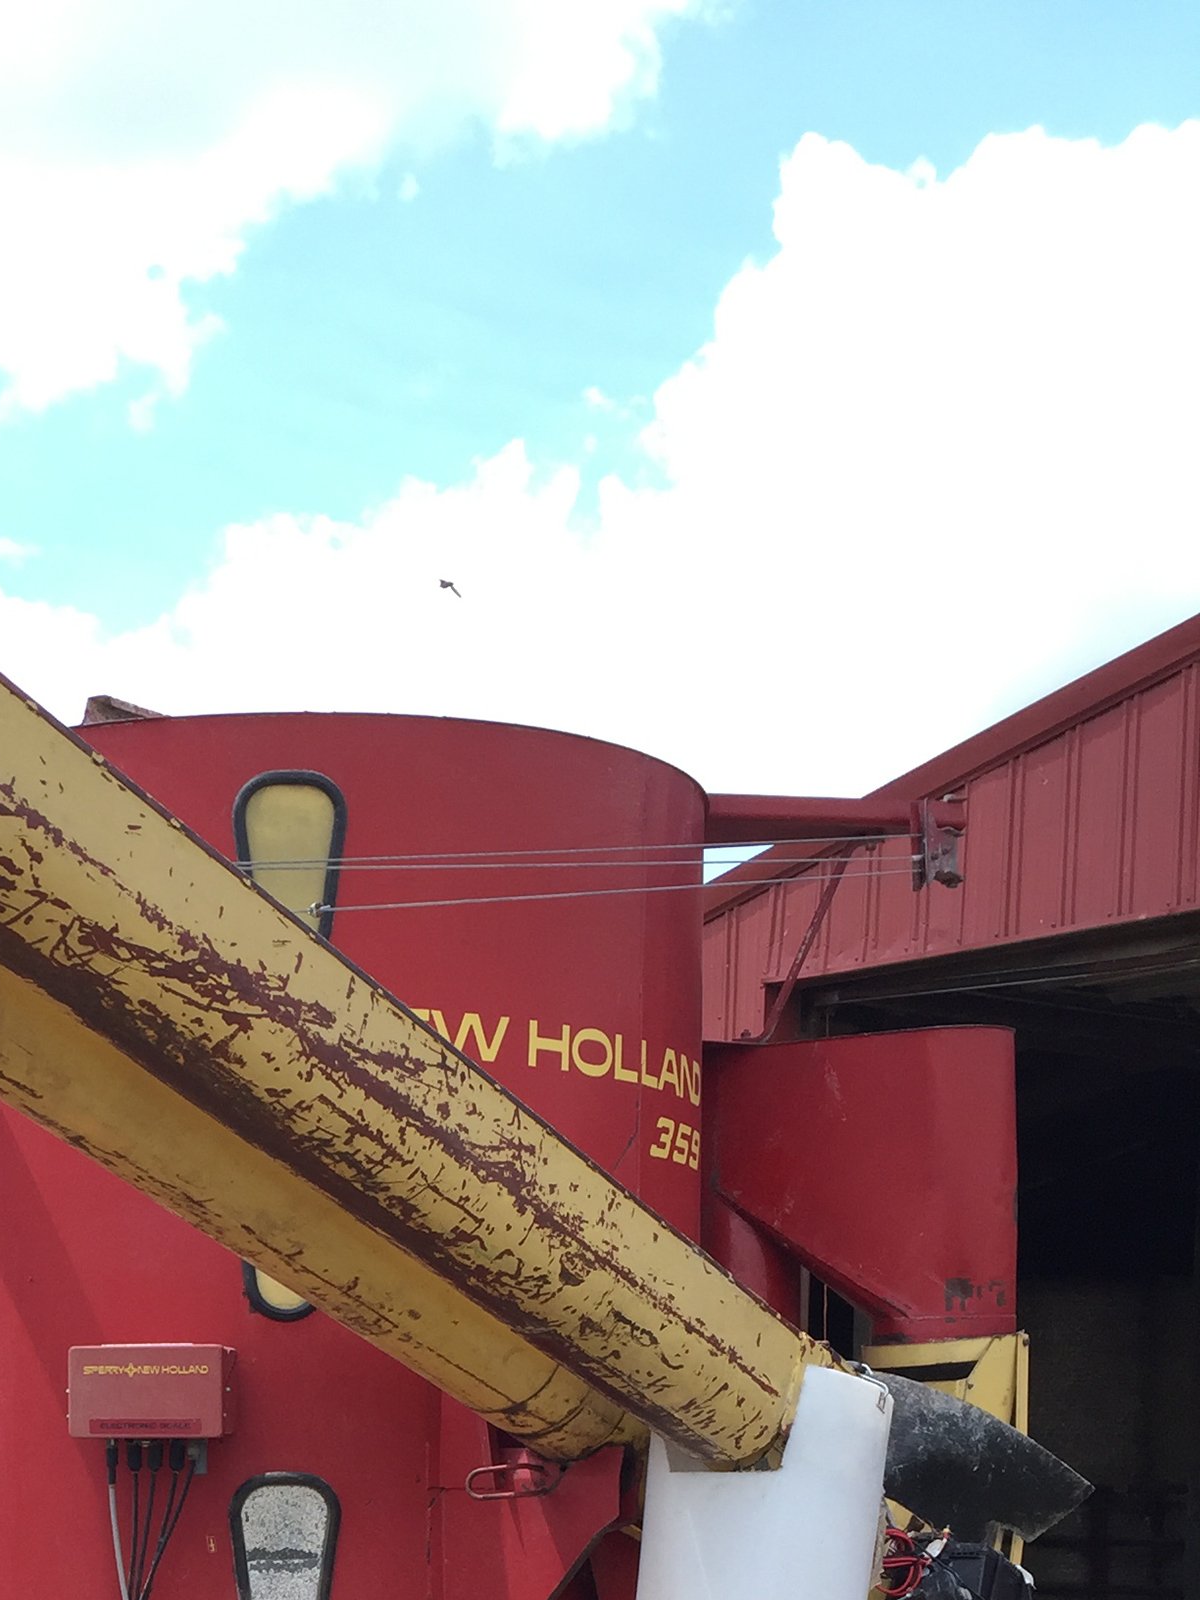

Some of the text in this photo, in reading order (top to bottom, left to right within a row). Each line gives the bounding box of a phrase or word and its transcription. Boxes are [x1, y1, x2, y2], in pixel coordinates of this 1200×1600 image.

[527, 1019, 701, 1107] HOLLAND
[649, 1116, 700, 1171] 359
[83, 1365, 209, 1375] SPERRY NEW HOLLAND
